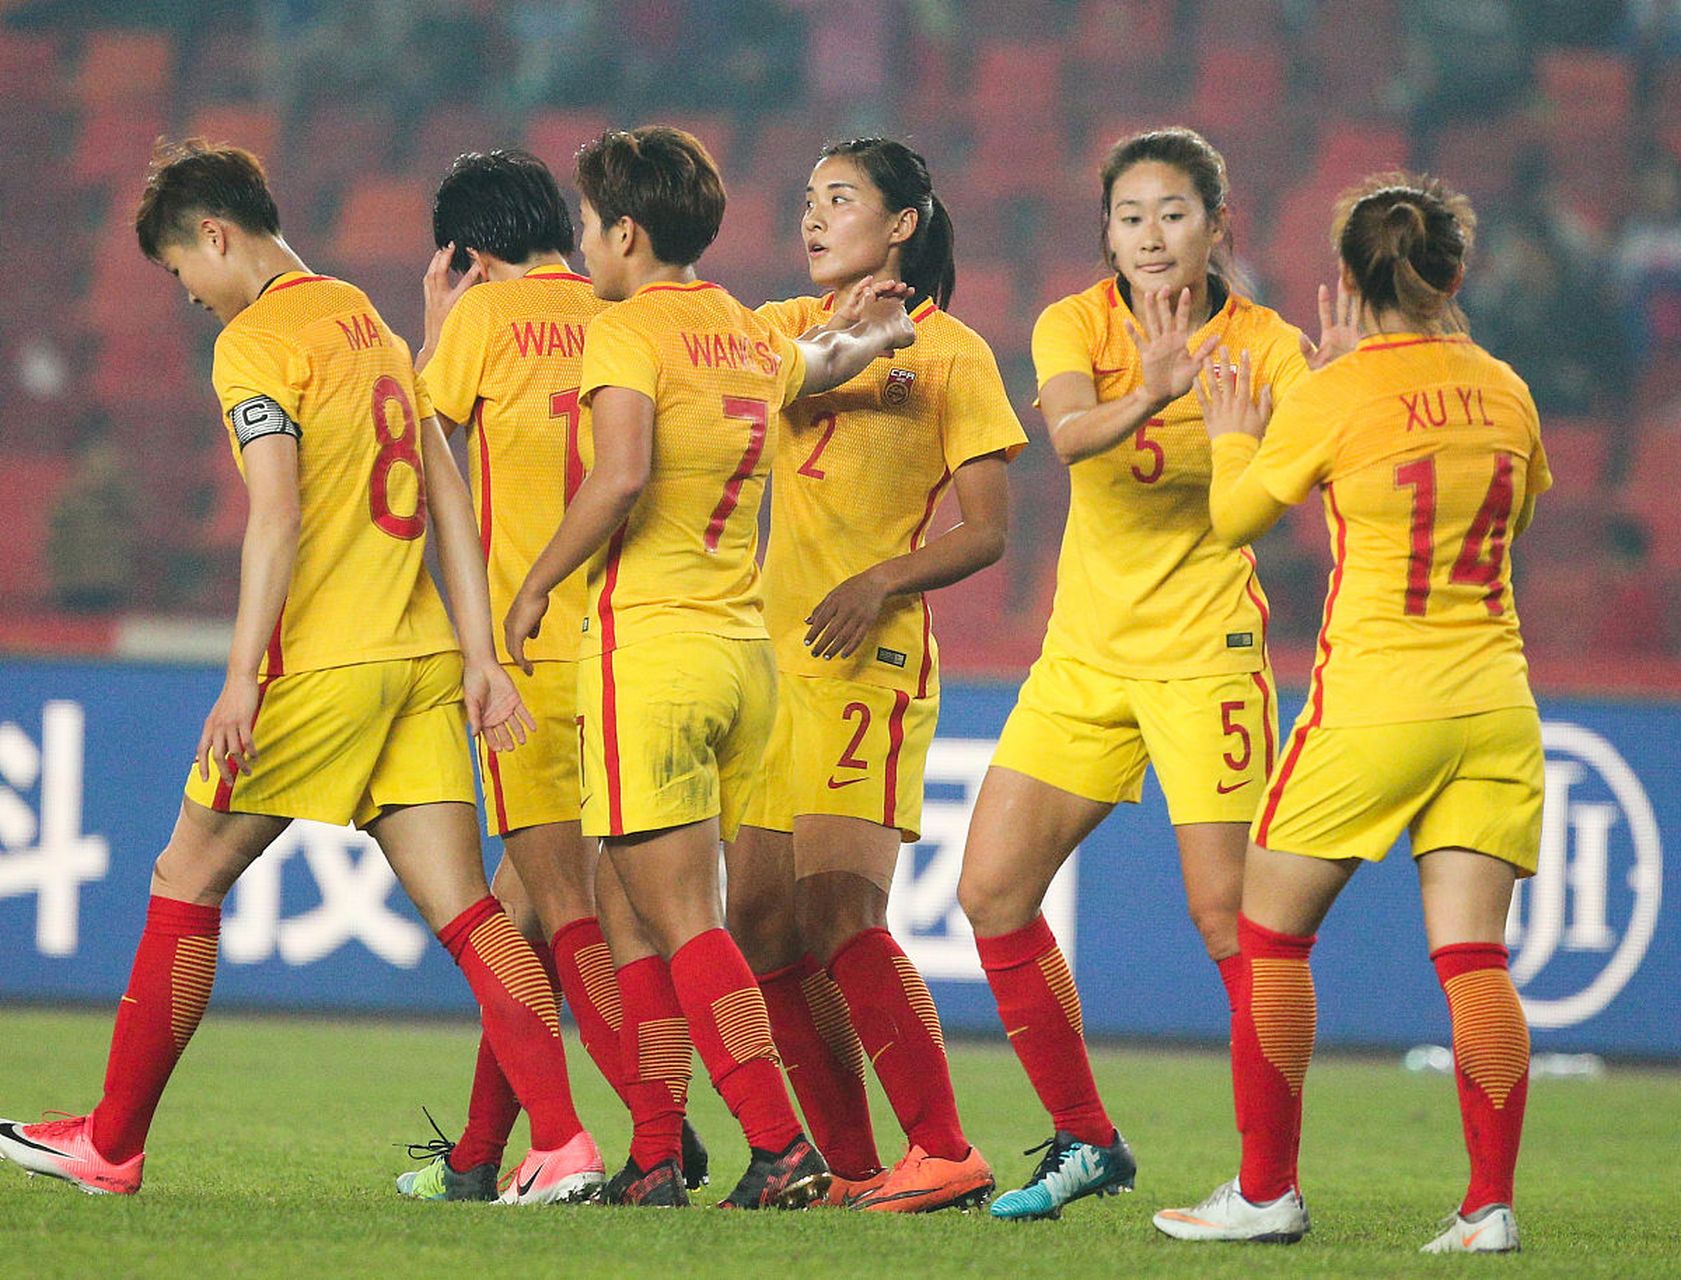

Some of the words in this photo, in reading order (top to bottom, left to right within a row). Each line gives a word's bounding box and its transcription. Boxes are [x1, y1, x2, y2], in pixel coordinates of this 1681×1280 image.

[336, 313, 383, 351] MA
[511, 311, 584, 358] WAN
[242, 403, 268, 427] C
[1399, 390, 1448, 432] XU
[369, 374, 428, 541] 8
[703, 394, 769, 555] 7
[797, 410, 837, 480] 2
[1131, 417, 1165, 484] 5
[1394, 451, 1514, 617] 14
[837, 702, 872, 769] 2
[1221, 701, 1252, 771] 5
